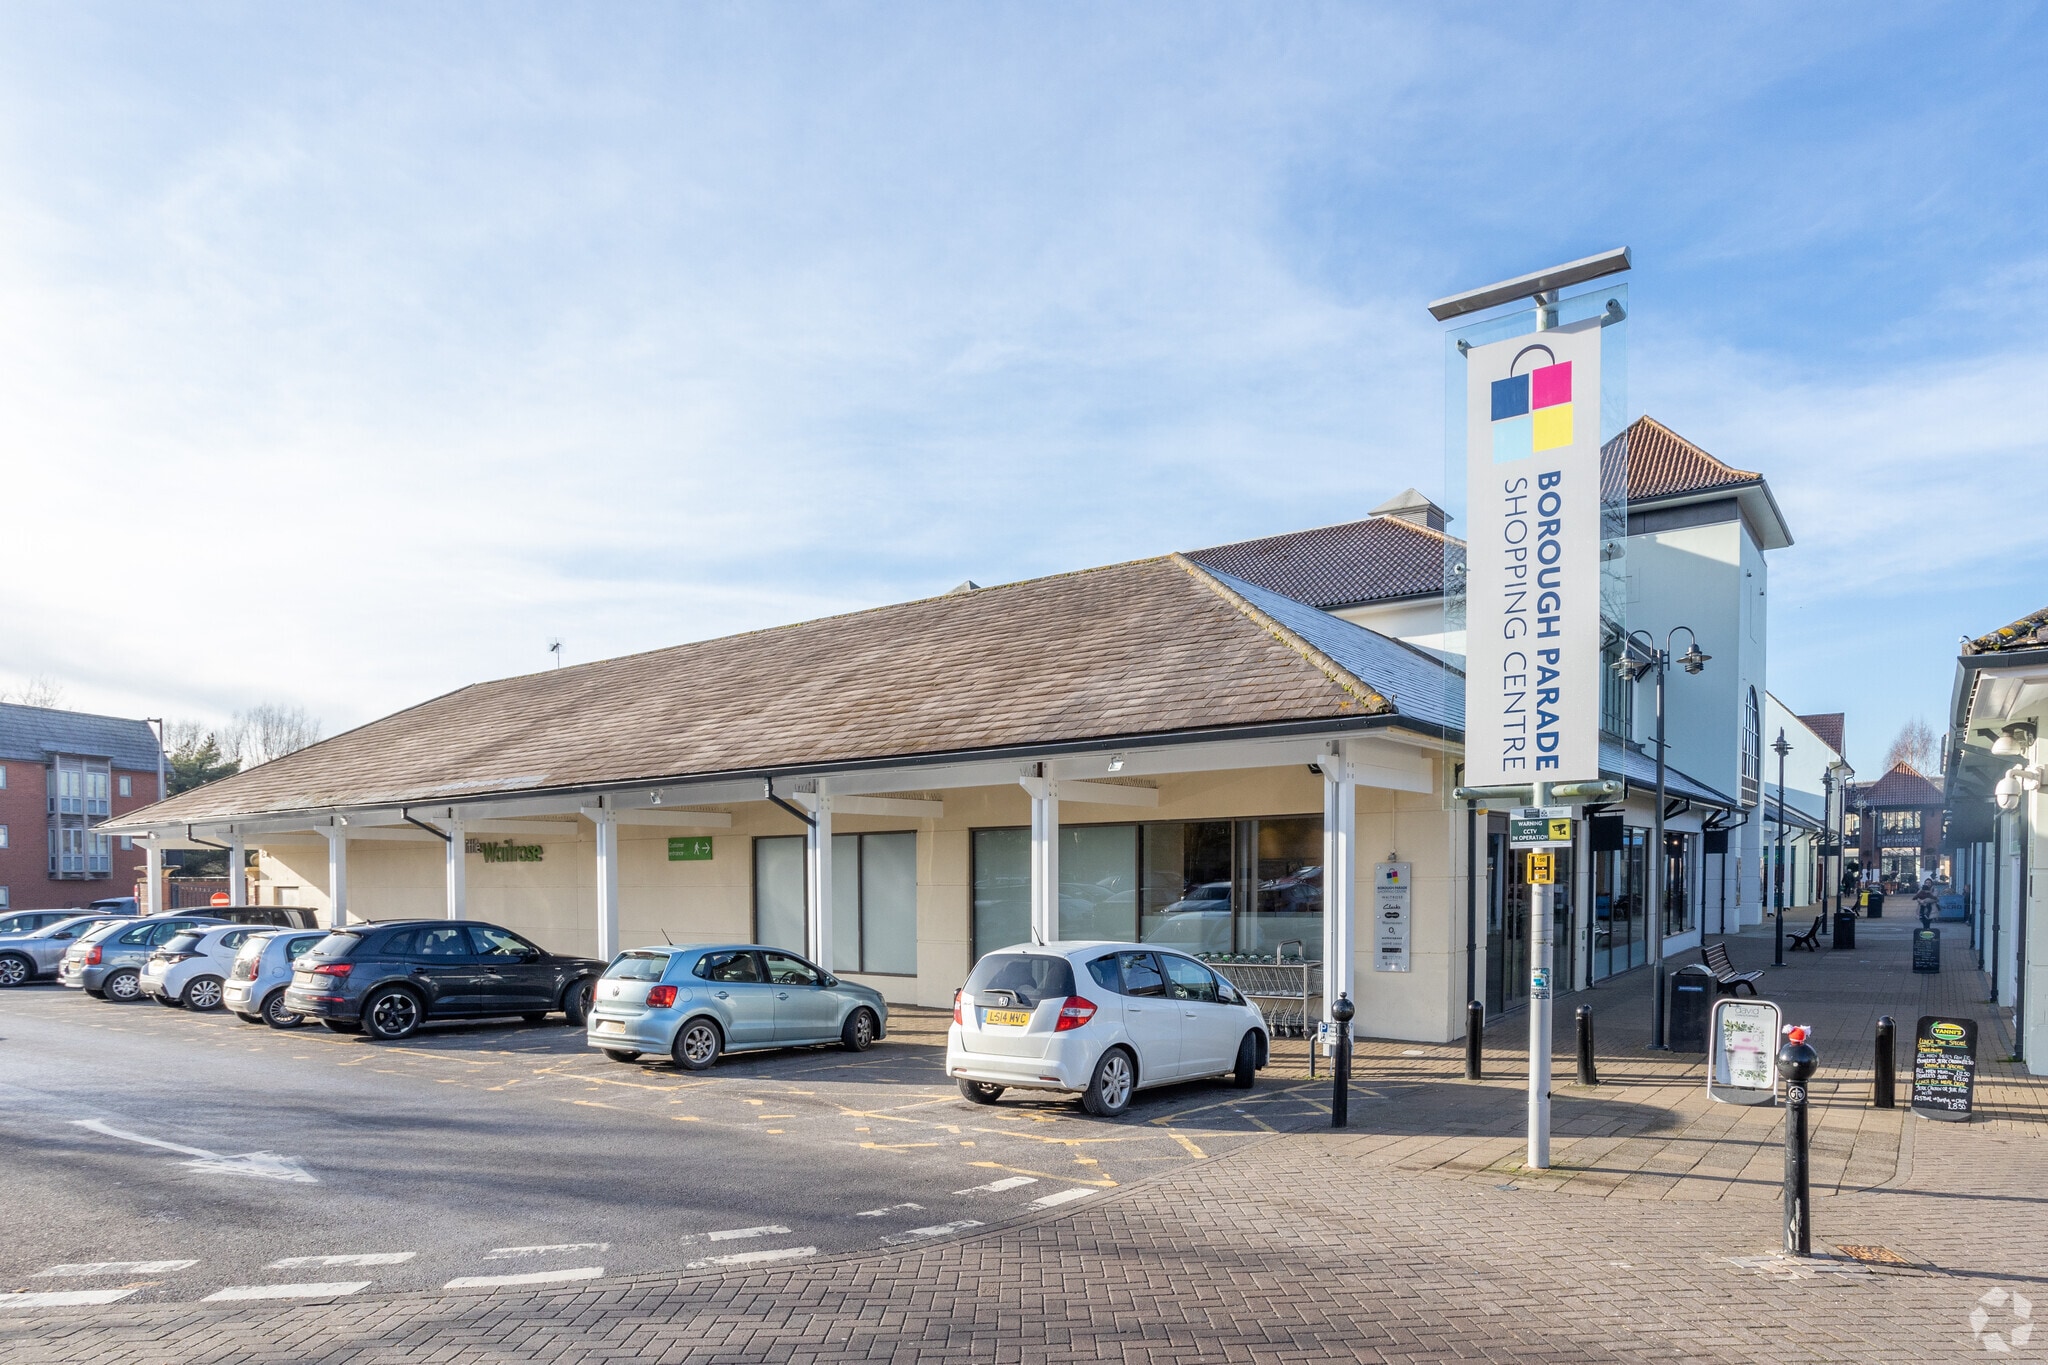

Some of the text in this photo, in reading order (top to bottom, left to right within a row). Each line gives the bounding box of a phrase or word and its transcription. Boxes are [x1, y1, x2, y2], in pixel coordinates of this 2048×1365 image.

[1502, 477, 1528, 772] SHOPPING CENTRE
[1536, 471, 1561, 771] BOROUGH PARADE
[465, 839, 544, 863] ittle Waitrose
[990, 1013, 1026, 1023] LS14 MVC
